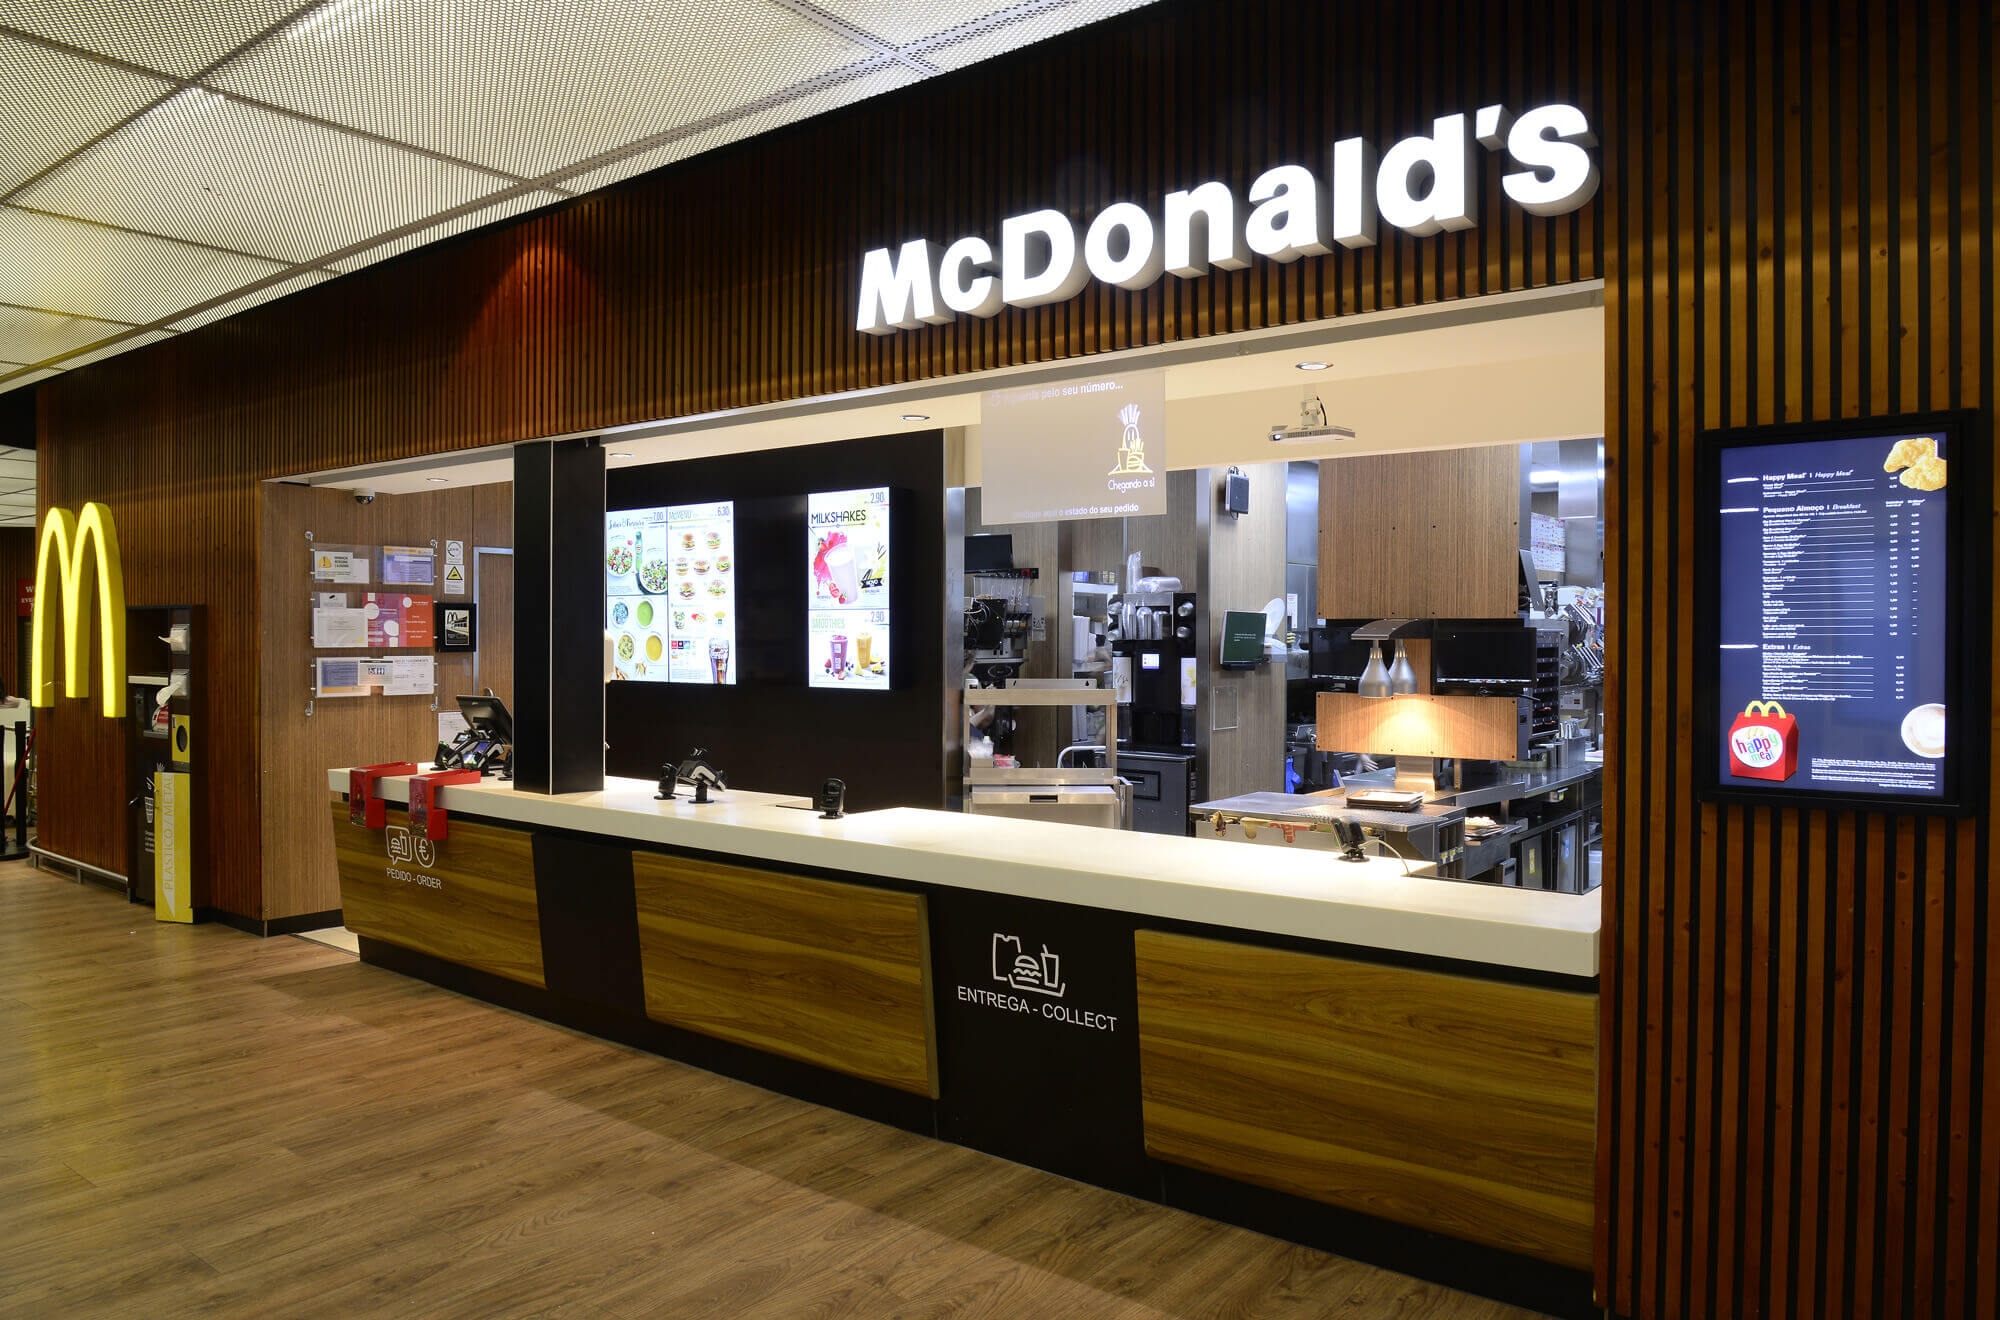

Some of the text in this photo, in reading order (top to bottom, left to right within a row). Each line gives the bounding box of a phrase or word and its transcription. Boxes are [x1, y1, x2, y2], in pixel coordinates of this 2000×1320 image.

[856, 103, 1598, 336] McDonald's
[1062, 384, 1079, 396] seu
[1080, 380, 1124, 394] número...
[1107, 478, 1142, 493] Chegando
[1142, 479, 1149, 487] a
[1088, 505, 1099, 514] do
[1099, 503, 1113, 514] seu
[1113, 503, 1139, 514] pedido
[1762, 506, 1796, 514] Pequeno
[811, 509, 867, 525] MILKSHAKES
[1735, 733, 1779, 754] happy
[1751, 749, 1775, 761] meal
[386, 867, 411, 882] PEDIDO
[416, 874, 442, 889] ORDER
[957, 985, 1030, 1014] ENTREGA
[1042, 1003, 1118, 1032] COLLECT
